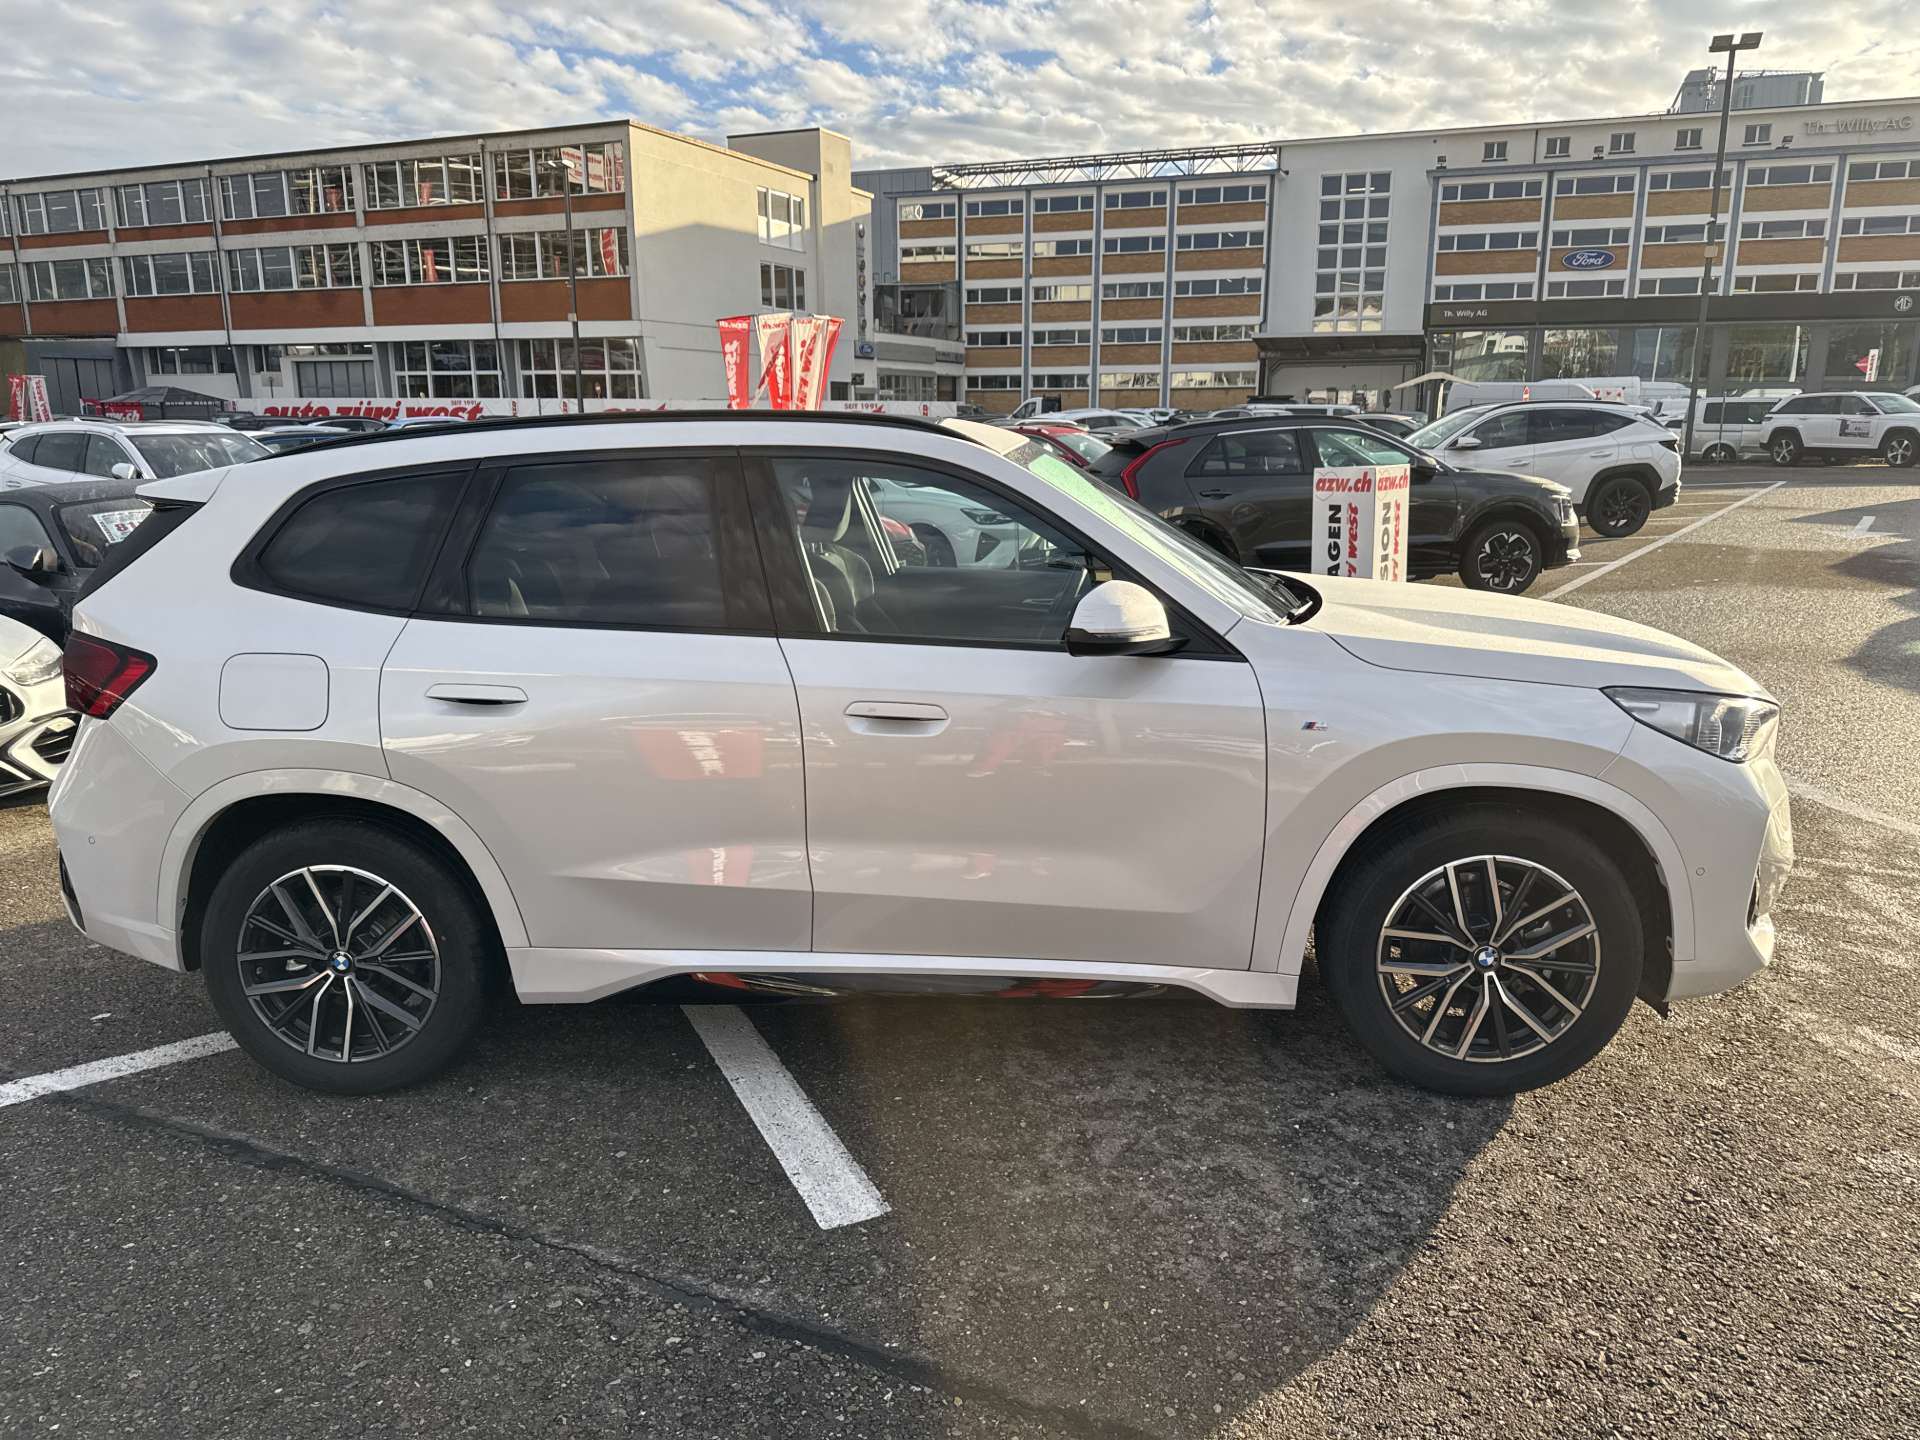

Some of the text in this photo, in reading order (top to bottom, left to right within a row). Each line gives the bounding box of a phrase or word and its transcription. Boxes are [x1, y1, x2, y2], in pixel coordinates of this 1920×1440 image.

[1837, 118, 1880, 136] Willy
[1885, 115, 1913, 130] AG
[1572, 252, 1605, 265] Ford
[1456, 310, 1475, 318] Willy
[1476, 309, 1488, 317] AG
[1895, 296, 1913, 312] MG
[264, 400, 484, 421] auto züri west
[1315, 471, 1373, 493] azw.ch
[1377, 467, 1409, 492] azw.ch
[1348, 502, 1359, 558] west
[1393, 499, 1401, 555] west
